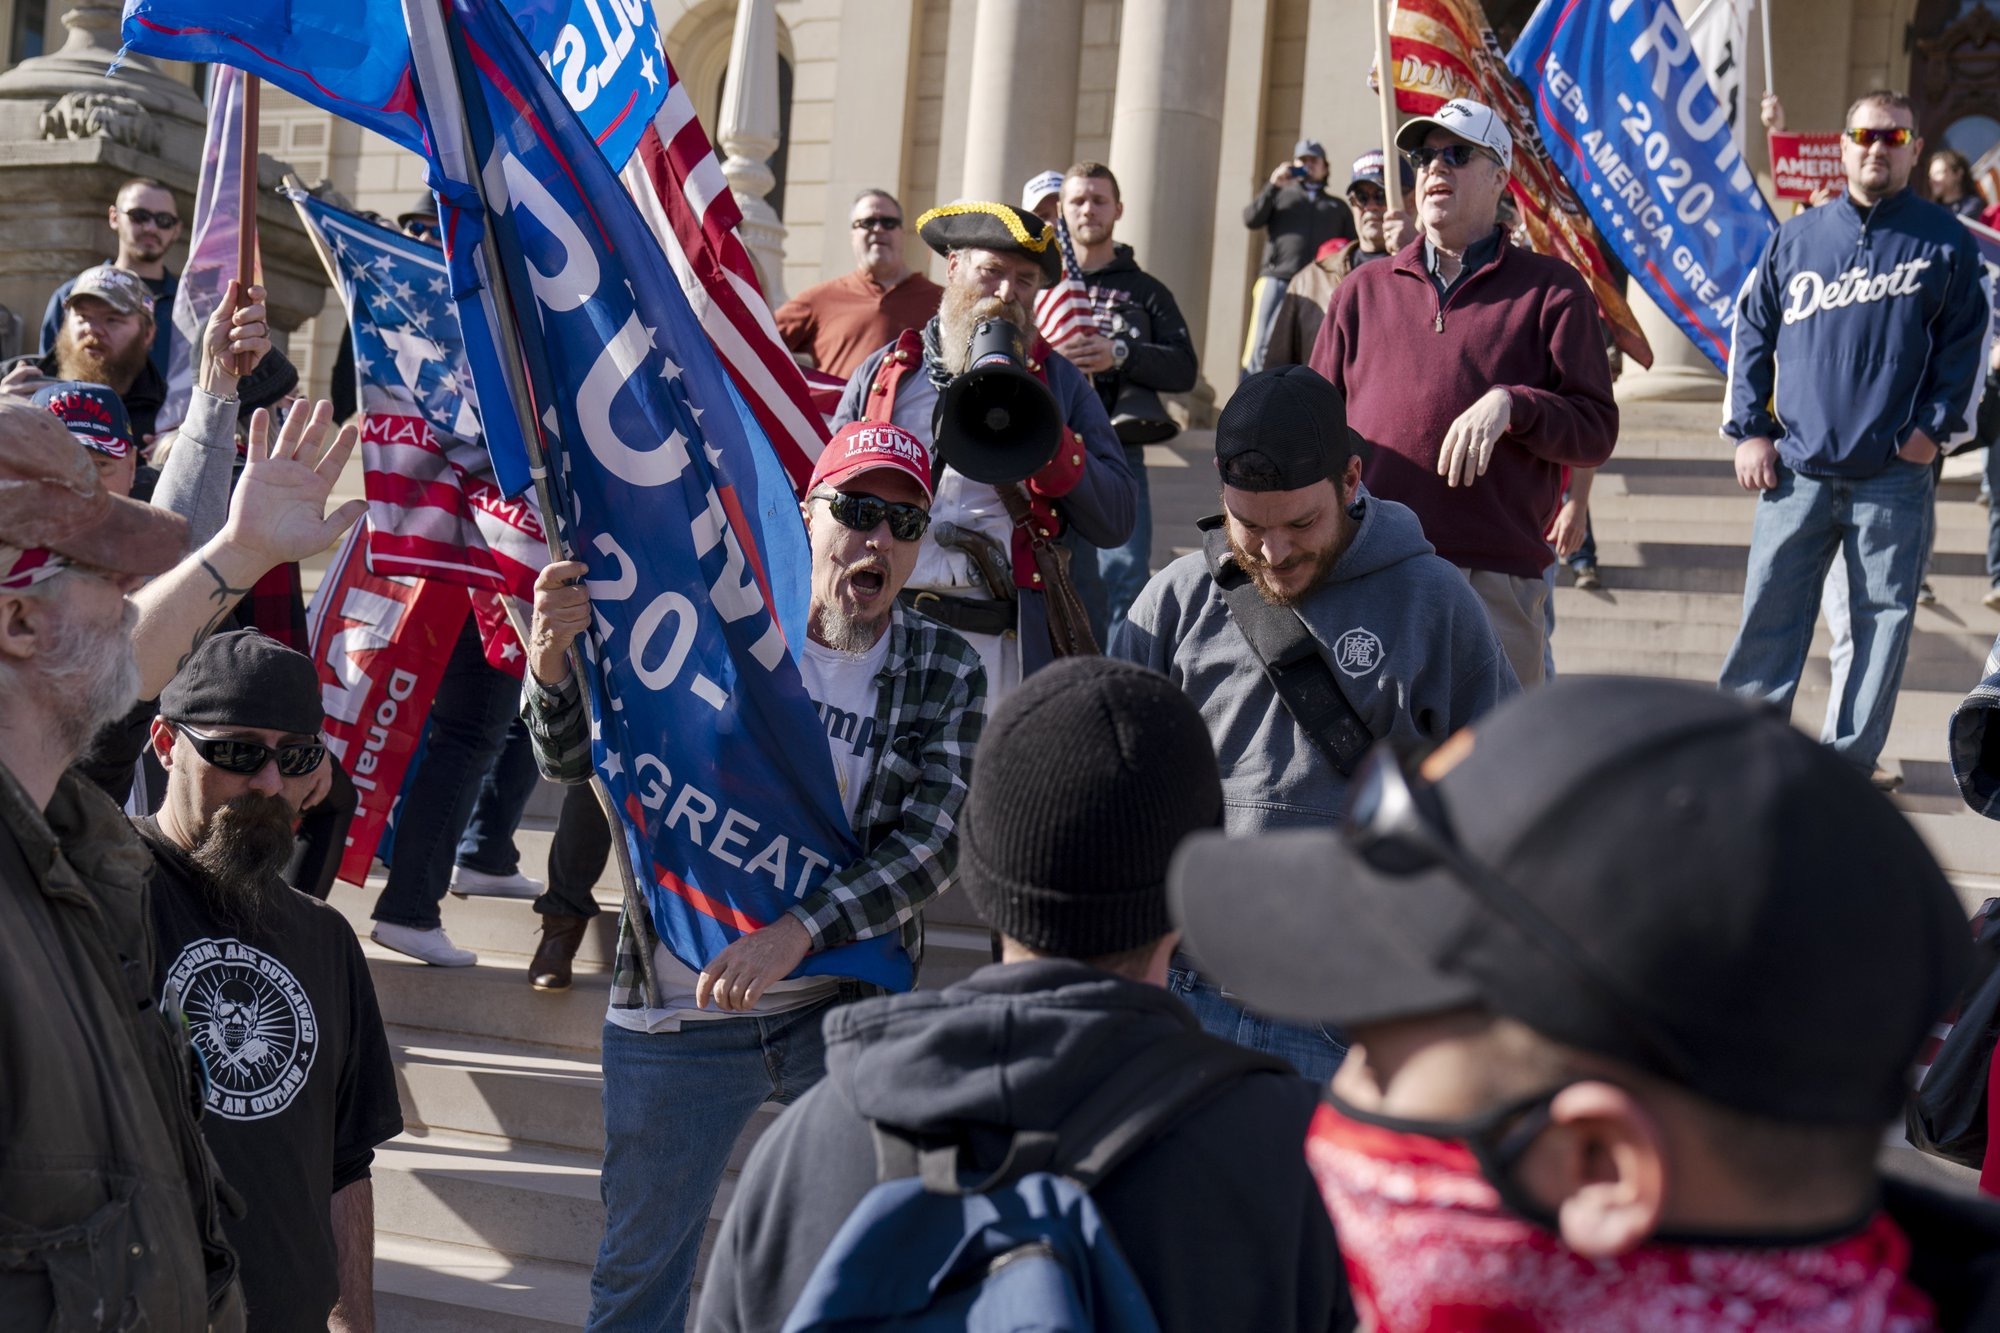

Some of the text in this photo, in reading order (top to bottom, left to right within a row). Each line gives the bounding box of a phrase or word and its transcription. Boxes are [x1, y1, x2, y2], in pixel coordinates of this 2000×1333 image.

[1544, 53, 1589, 124] KEEP
[1582, 129, 1674, 250] AMERICA
[1799, 143, 1841, 158] MAKE
[1784, 257, 1931, 325] Detroit
[49, 394, 113, 424] RUMP
[361, 416, 442, 449] MAK
[846, 431, 922, 459] TRUMP
[863, 446, 892, 454] AMERICA
[633, 753, 842, 899] GREAT
[224, 944, 257, 966] ARE
[259, 959, 313, 1043] OUTLAWED
[222, 1096, 246, 1115] AN
[250, 1064, 304, 1114] OUTLAW
